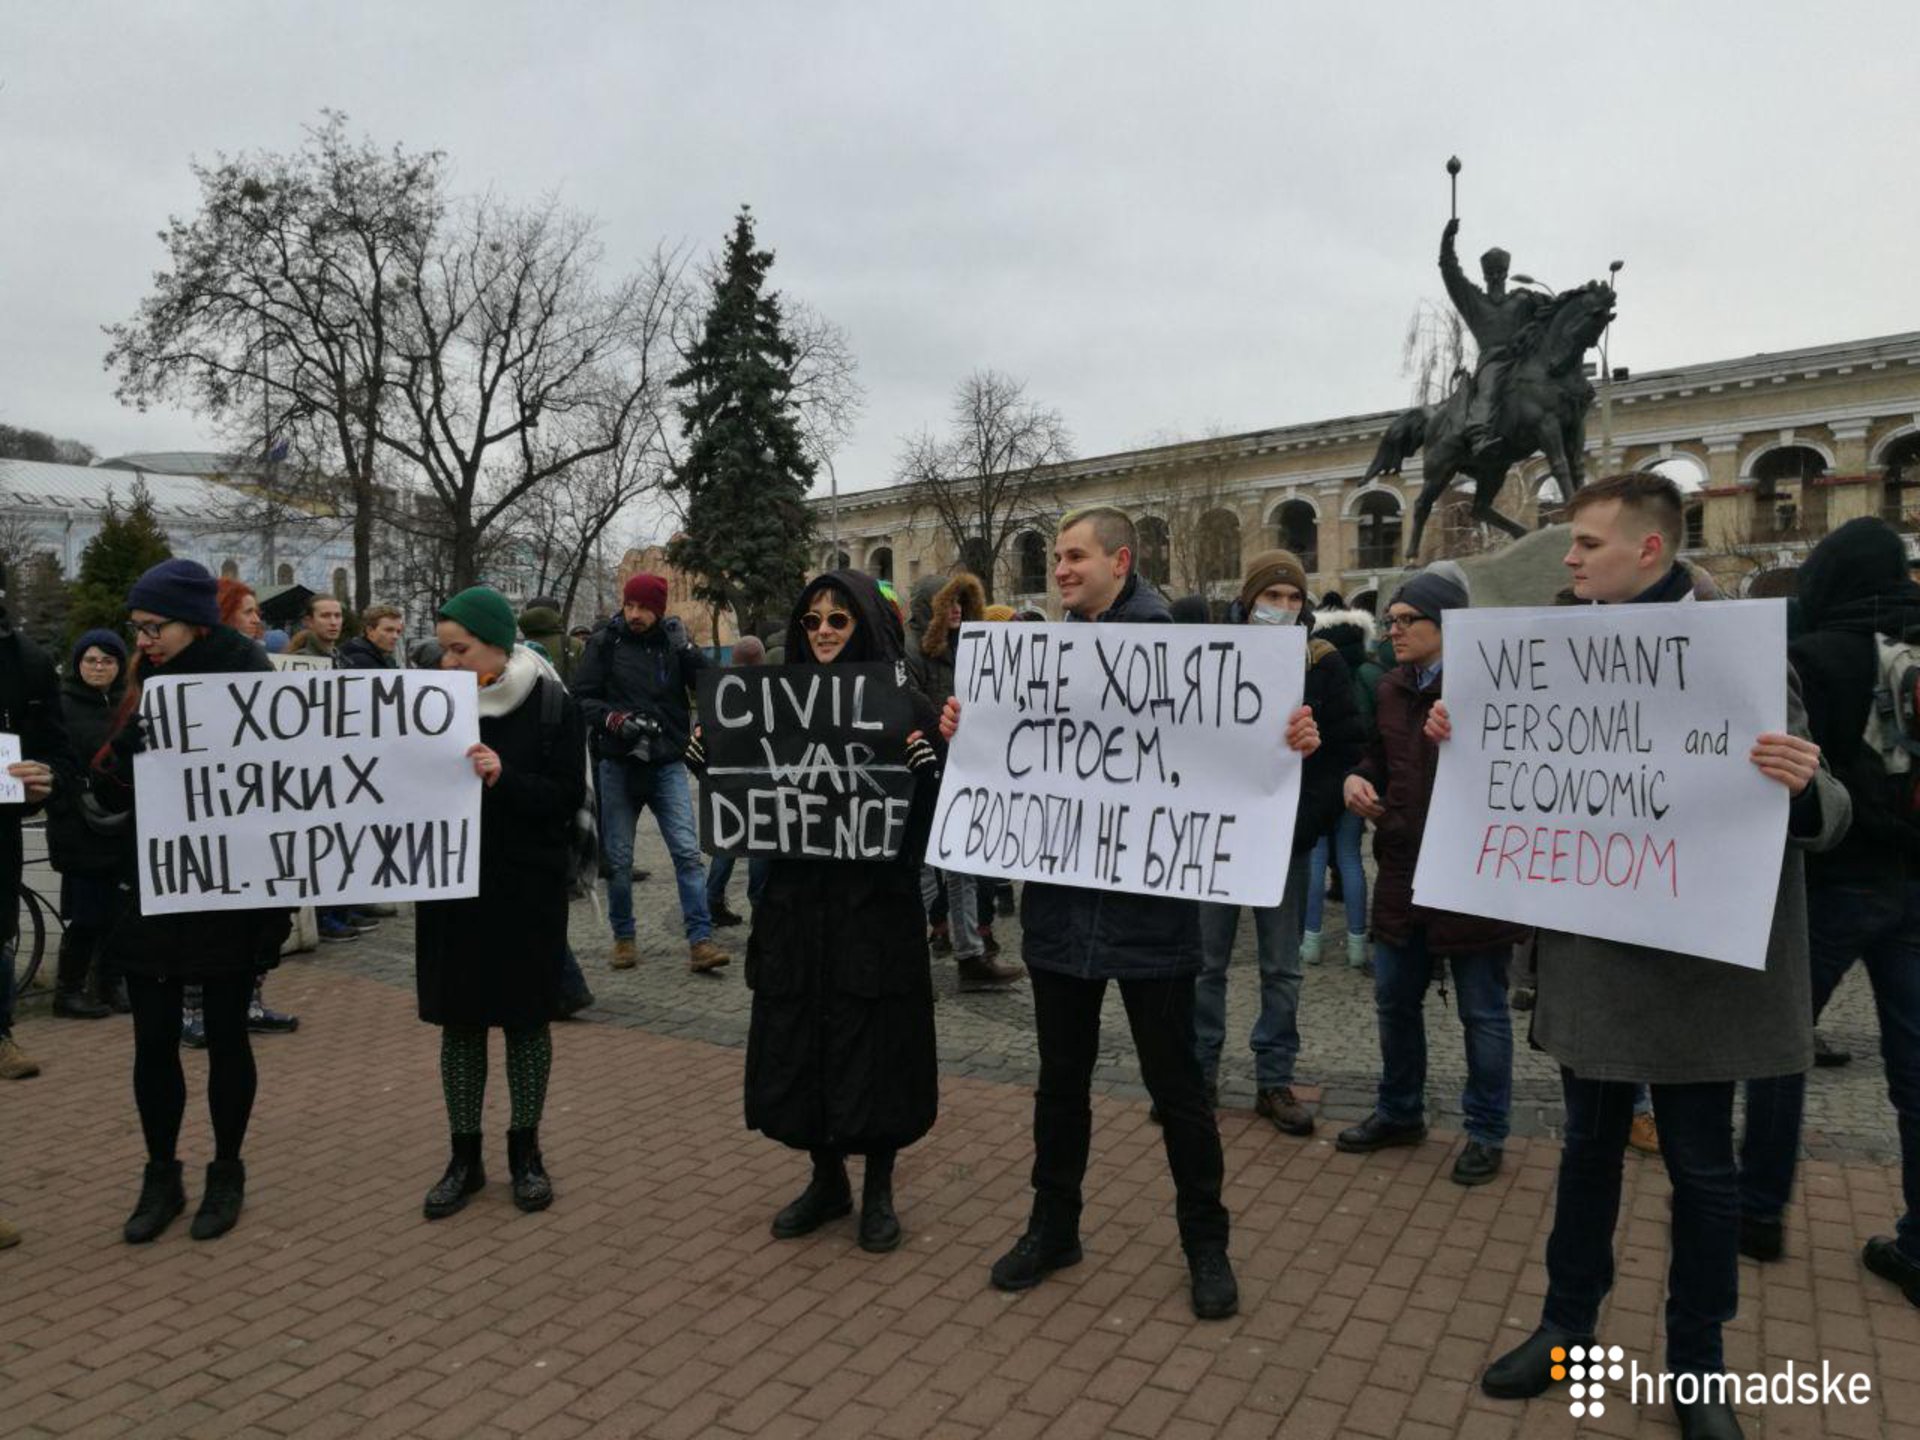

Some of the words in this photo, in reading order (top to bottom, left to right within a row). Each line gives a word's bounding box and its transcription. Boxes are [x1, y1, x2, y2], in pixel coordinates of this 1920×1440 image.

[1095, 638, 1263, 727] ХОДЯТЬ
[1478, 638, 1547, 691] WE
[1568, 634, 1690, 690] WANT
[144, 681, 208, 753] НЕ
[227, 674, 455, 747] ХОЧЕМО
[715, 674, 884, 733] CIVIL
[1482, 699, 1652, 755] PERSONAL
[1684, 720, 1729, 756] and
[760, 737, 887, 796] WAR
[149, 833, 250, 896] НАЦ.
[266, 818, 468, 896] ДРУЖИН
[710, 786, 909, 860] DEFENCE
[938, 786, 1083, 875] СВОБОДИ
[1094, 802, 1130, 883] НЕ
[1143, 806, 1237, 896] БУДЕ
[1476, 824, 1679, 897] FREEDOM
